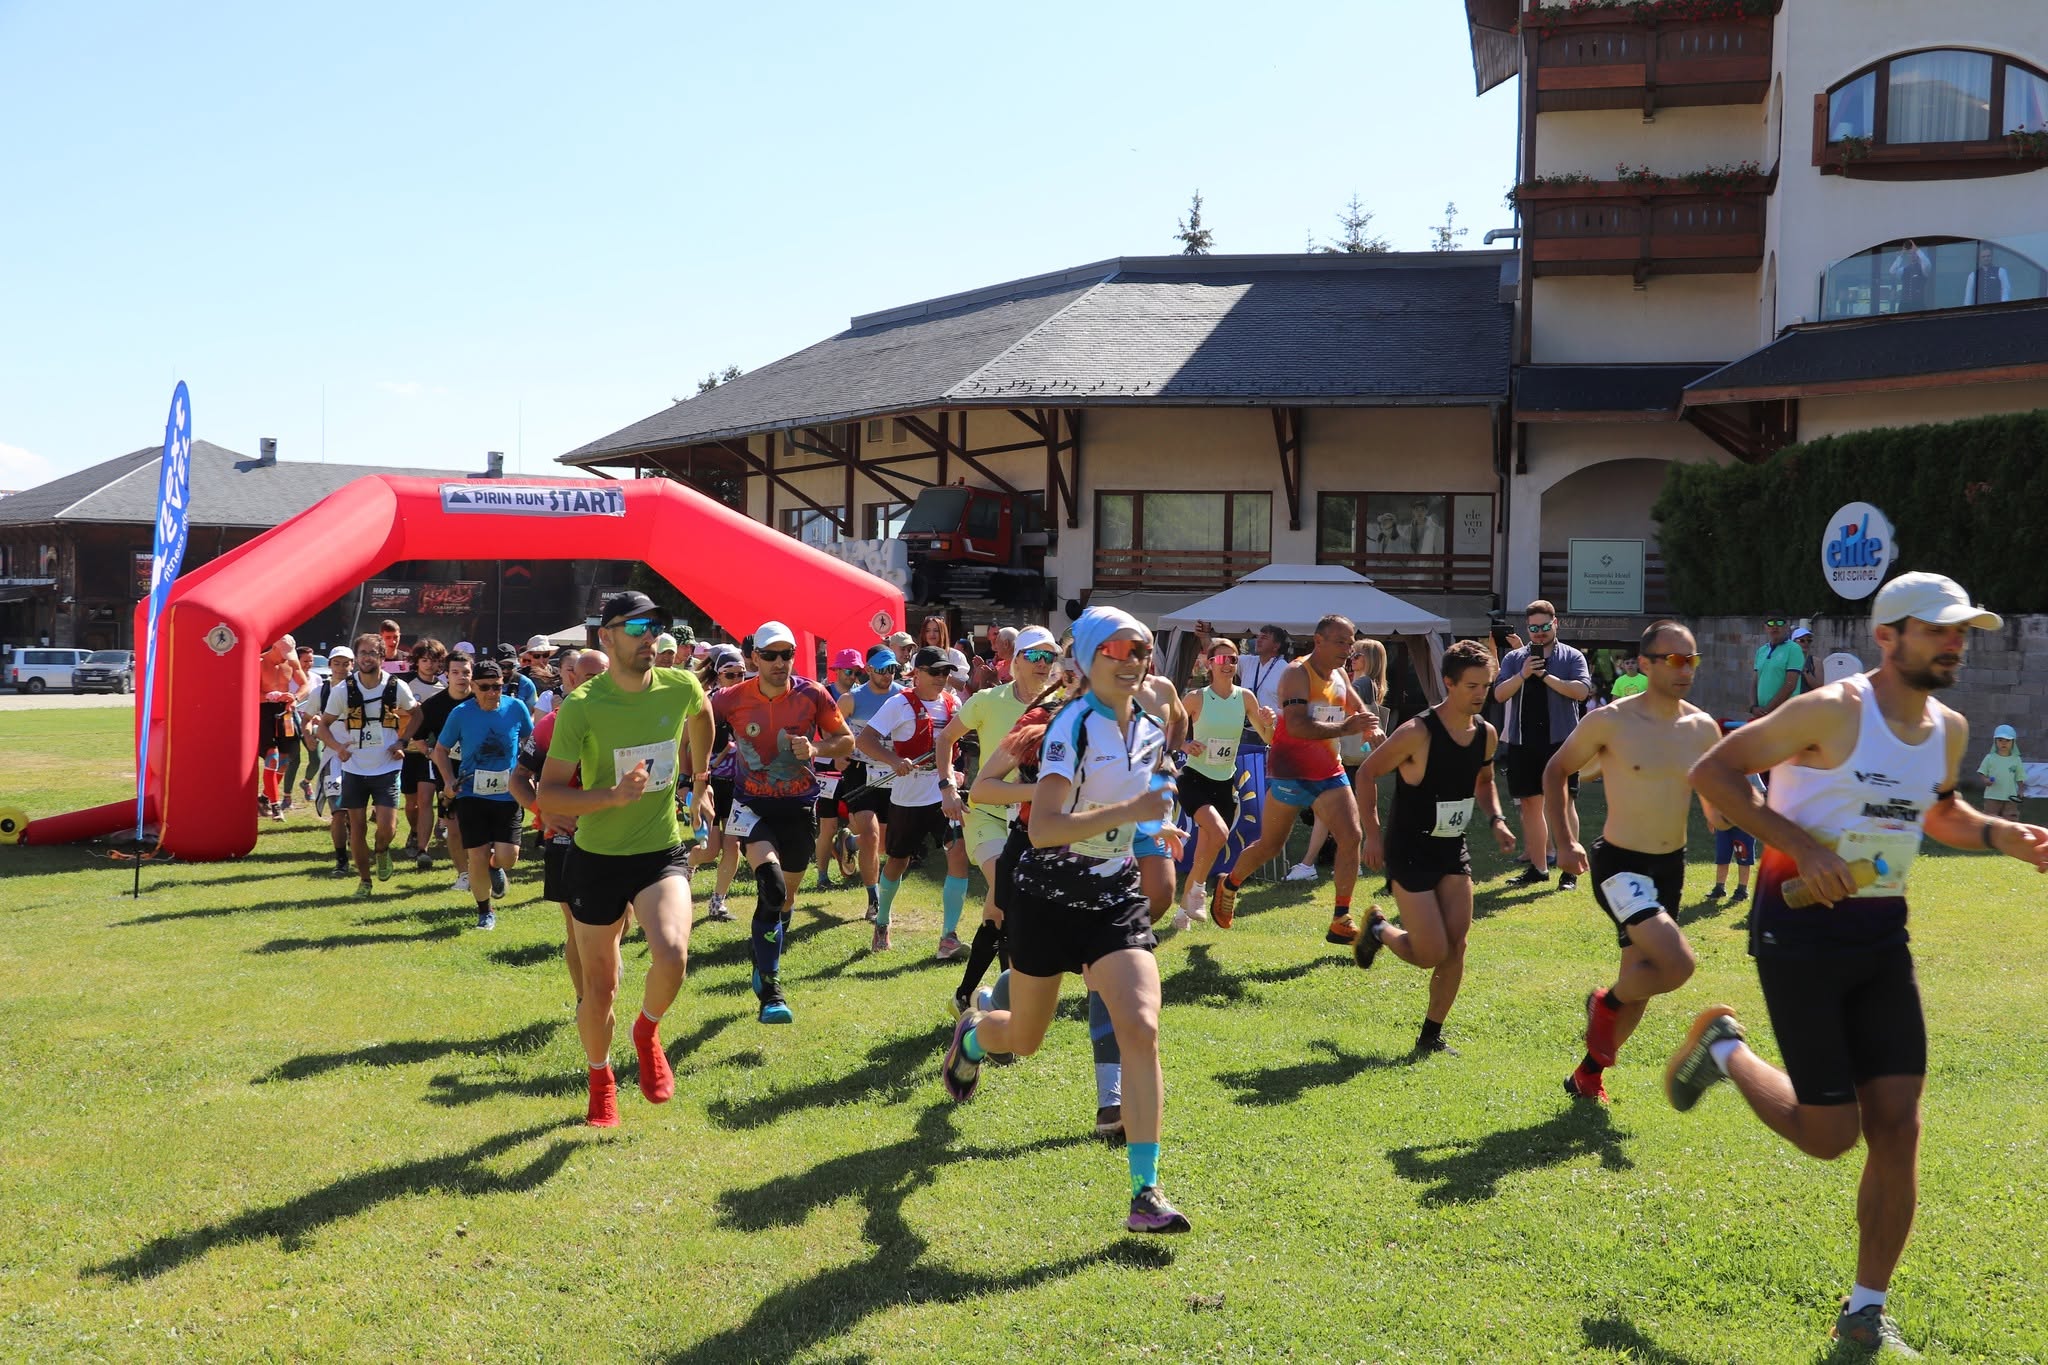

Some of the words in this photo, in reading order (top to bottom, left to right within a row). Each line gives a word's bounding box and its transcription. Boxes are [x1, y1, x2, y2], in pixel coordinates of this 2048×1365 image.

[160, 397, 185, 545] next
[161, 436, 189, 569] LEVEL
[475, 491, 512, 505] PIRIN
[516, 492, 545, 506] RUN
[549, 490, 618, 513] START
[1463, 520, 1483, 528] ven
[1827, 513, 1882, 568] elite
[1615, 571, 1631, 579] Hotel
[1833, 571, 1845, 581] SKI
[1846, 570, 1878, 581] SCHOOL
[1217, 746, 1231, 758] 46
[486, 778, 498, 789] 14
[1449, 811, 1463, 827] 48
[1629, 881, 1644, 897] 2
